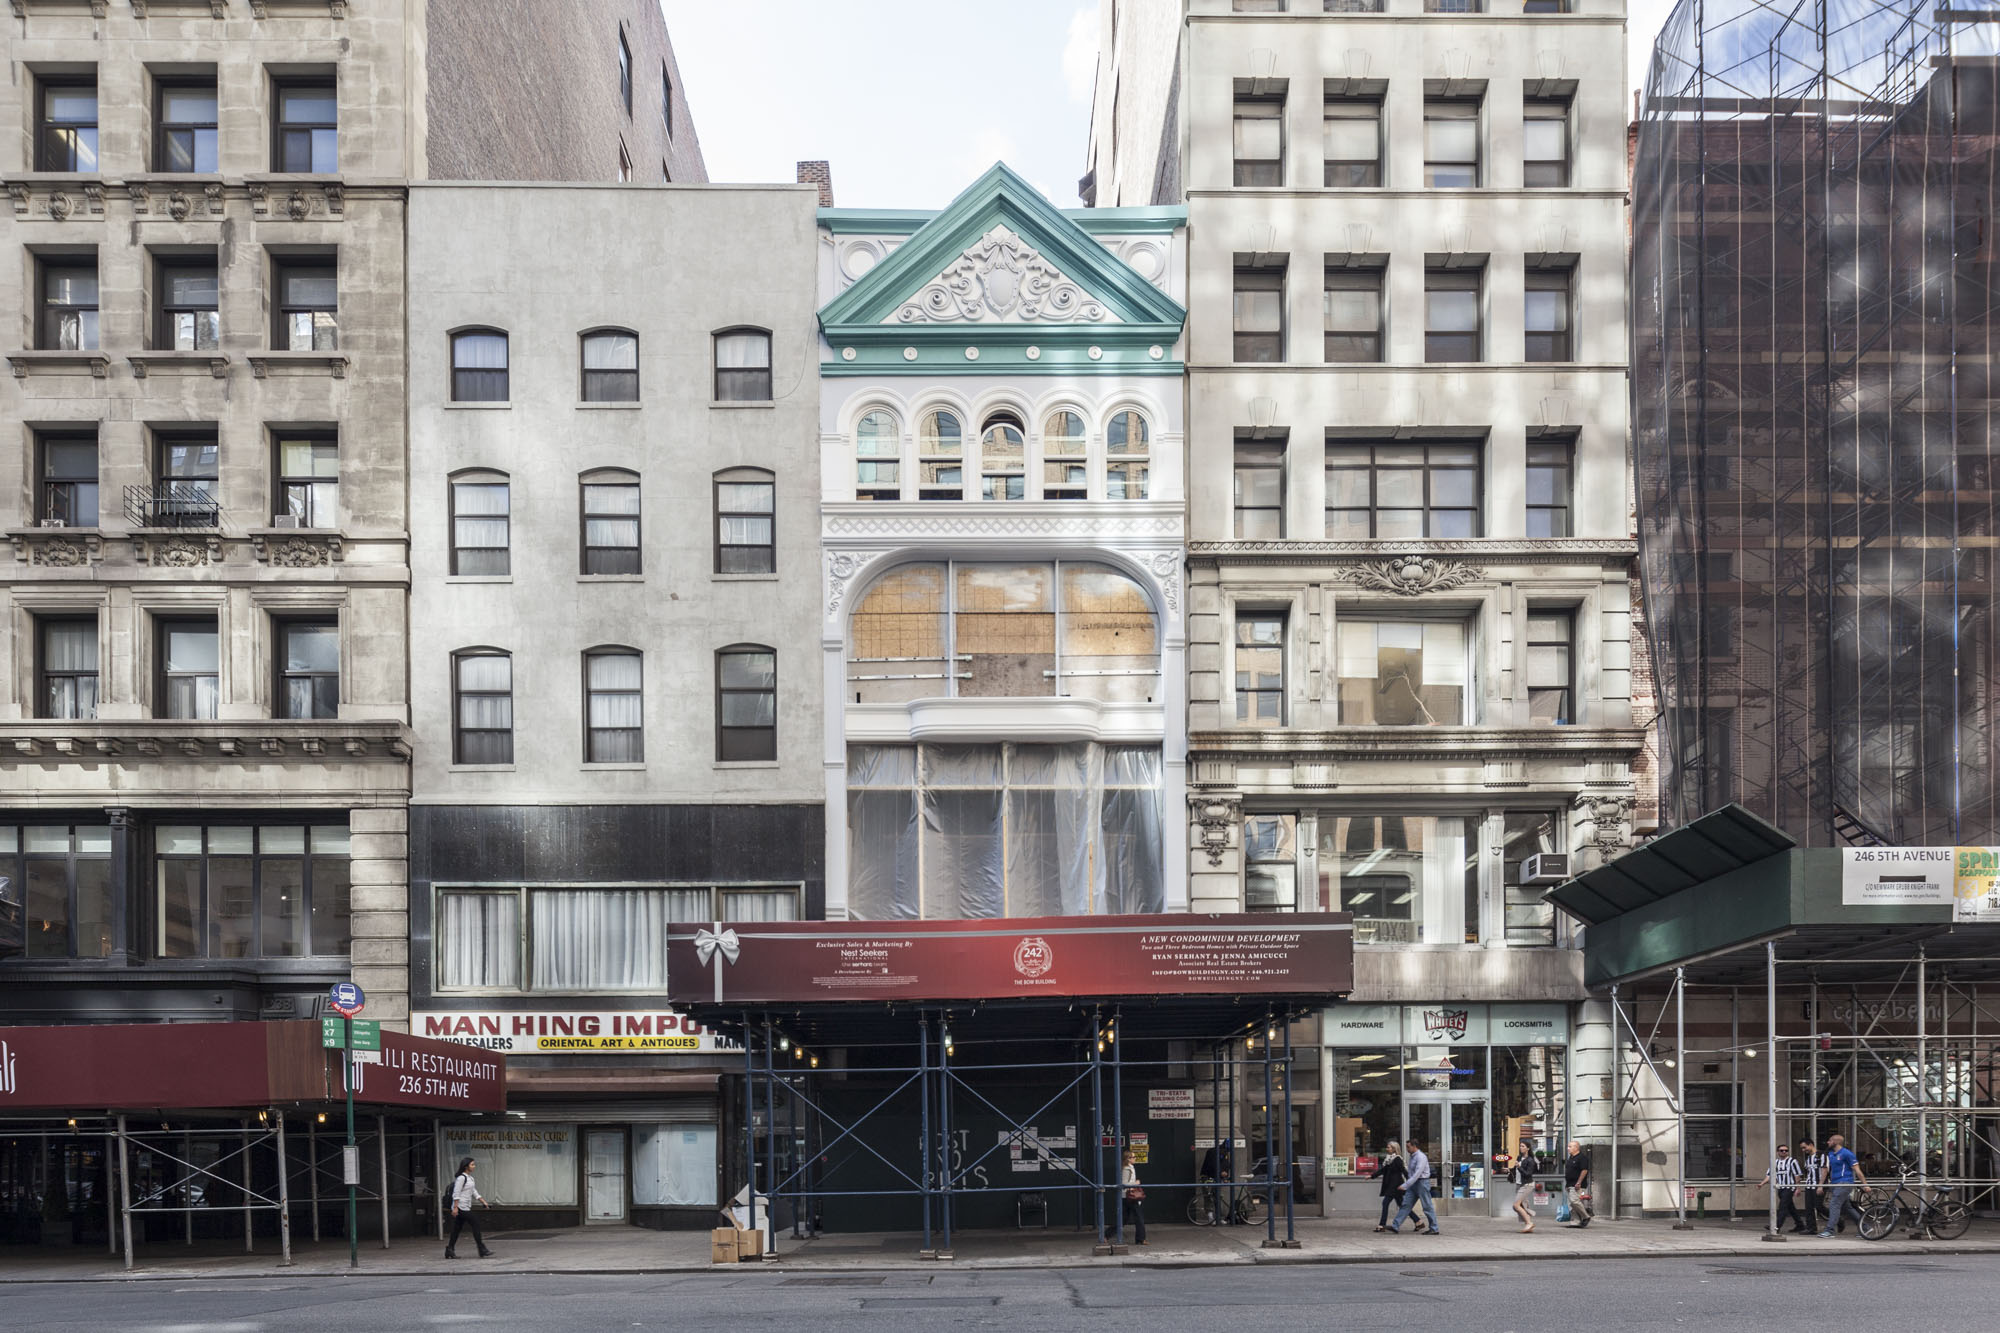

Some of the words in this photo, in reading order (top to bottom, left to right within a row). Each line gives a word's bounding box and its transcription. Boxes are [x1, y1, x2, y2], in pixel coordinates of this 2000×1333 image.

[1854, 851, 1875, 862] 246
[1878, 851, 1900, 861] 5TH
[1903, 850, 1951, 860] AVENUE
[1959, 852, 1999, 868] SPRI
[1024, 948, 1042, 958] 242
[426, 1016, 500, 1035] MAN
[512, 1016, 600, 1036] HING
[613, 1016, 718, 1036] IMPO
[540, 1039, 594, 1047] ORIENTAL
[601, 1039, 623, 1047] ART
[640, 1039, 696, 1047] ANTIQUES
[412, 1052, 497, 1080] RESTAURANT
[400, 1075, 422, 1094] 236
[424, 1078, 446, 1096] 5TH
[450, 1082, 470, 1098] AVE
[447, 1131, 467, 1140] MAN
[470, 1131, 496, 1141] HING
[498, 1131, 542, 1141] IMPORTS
